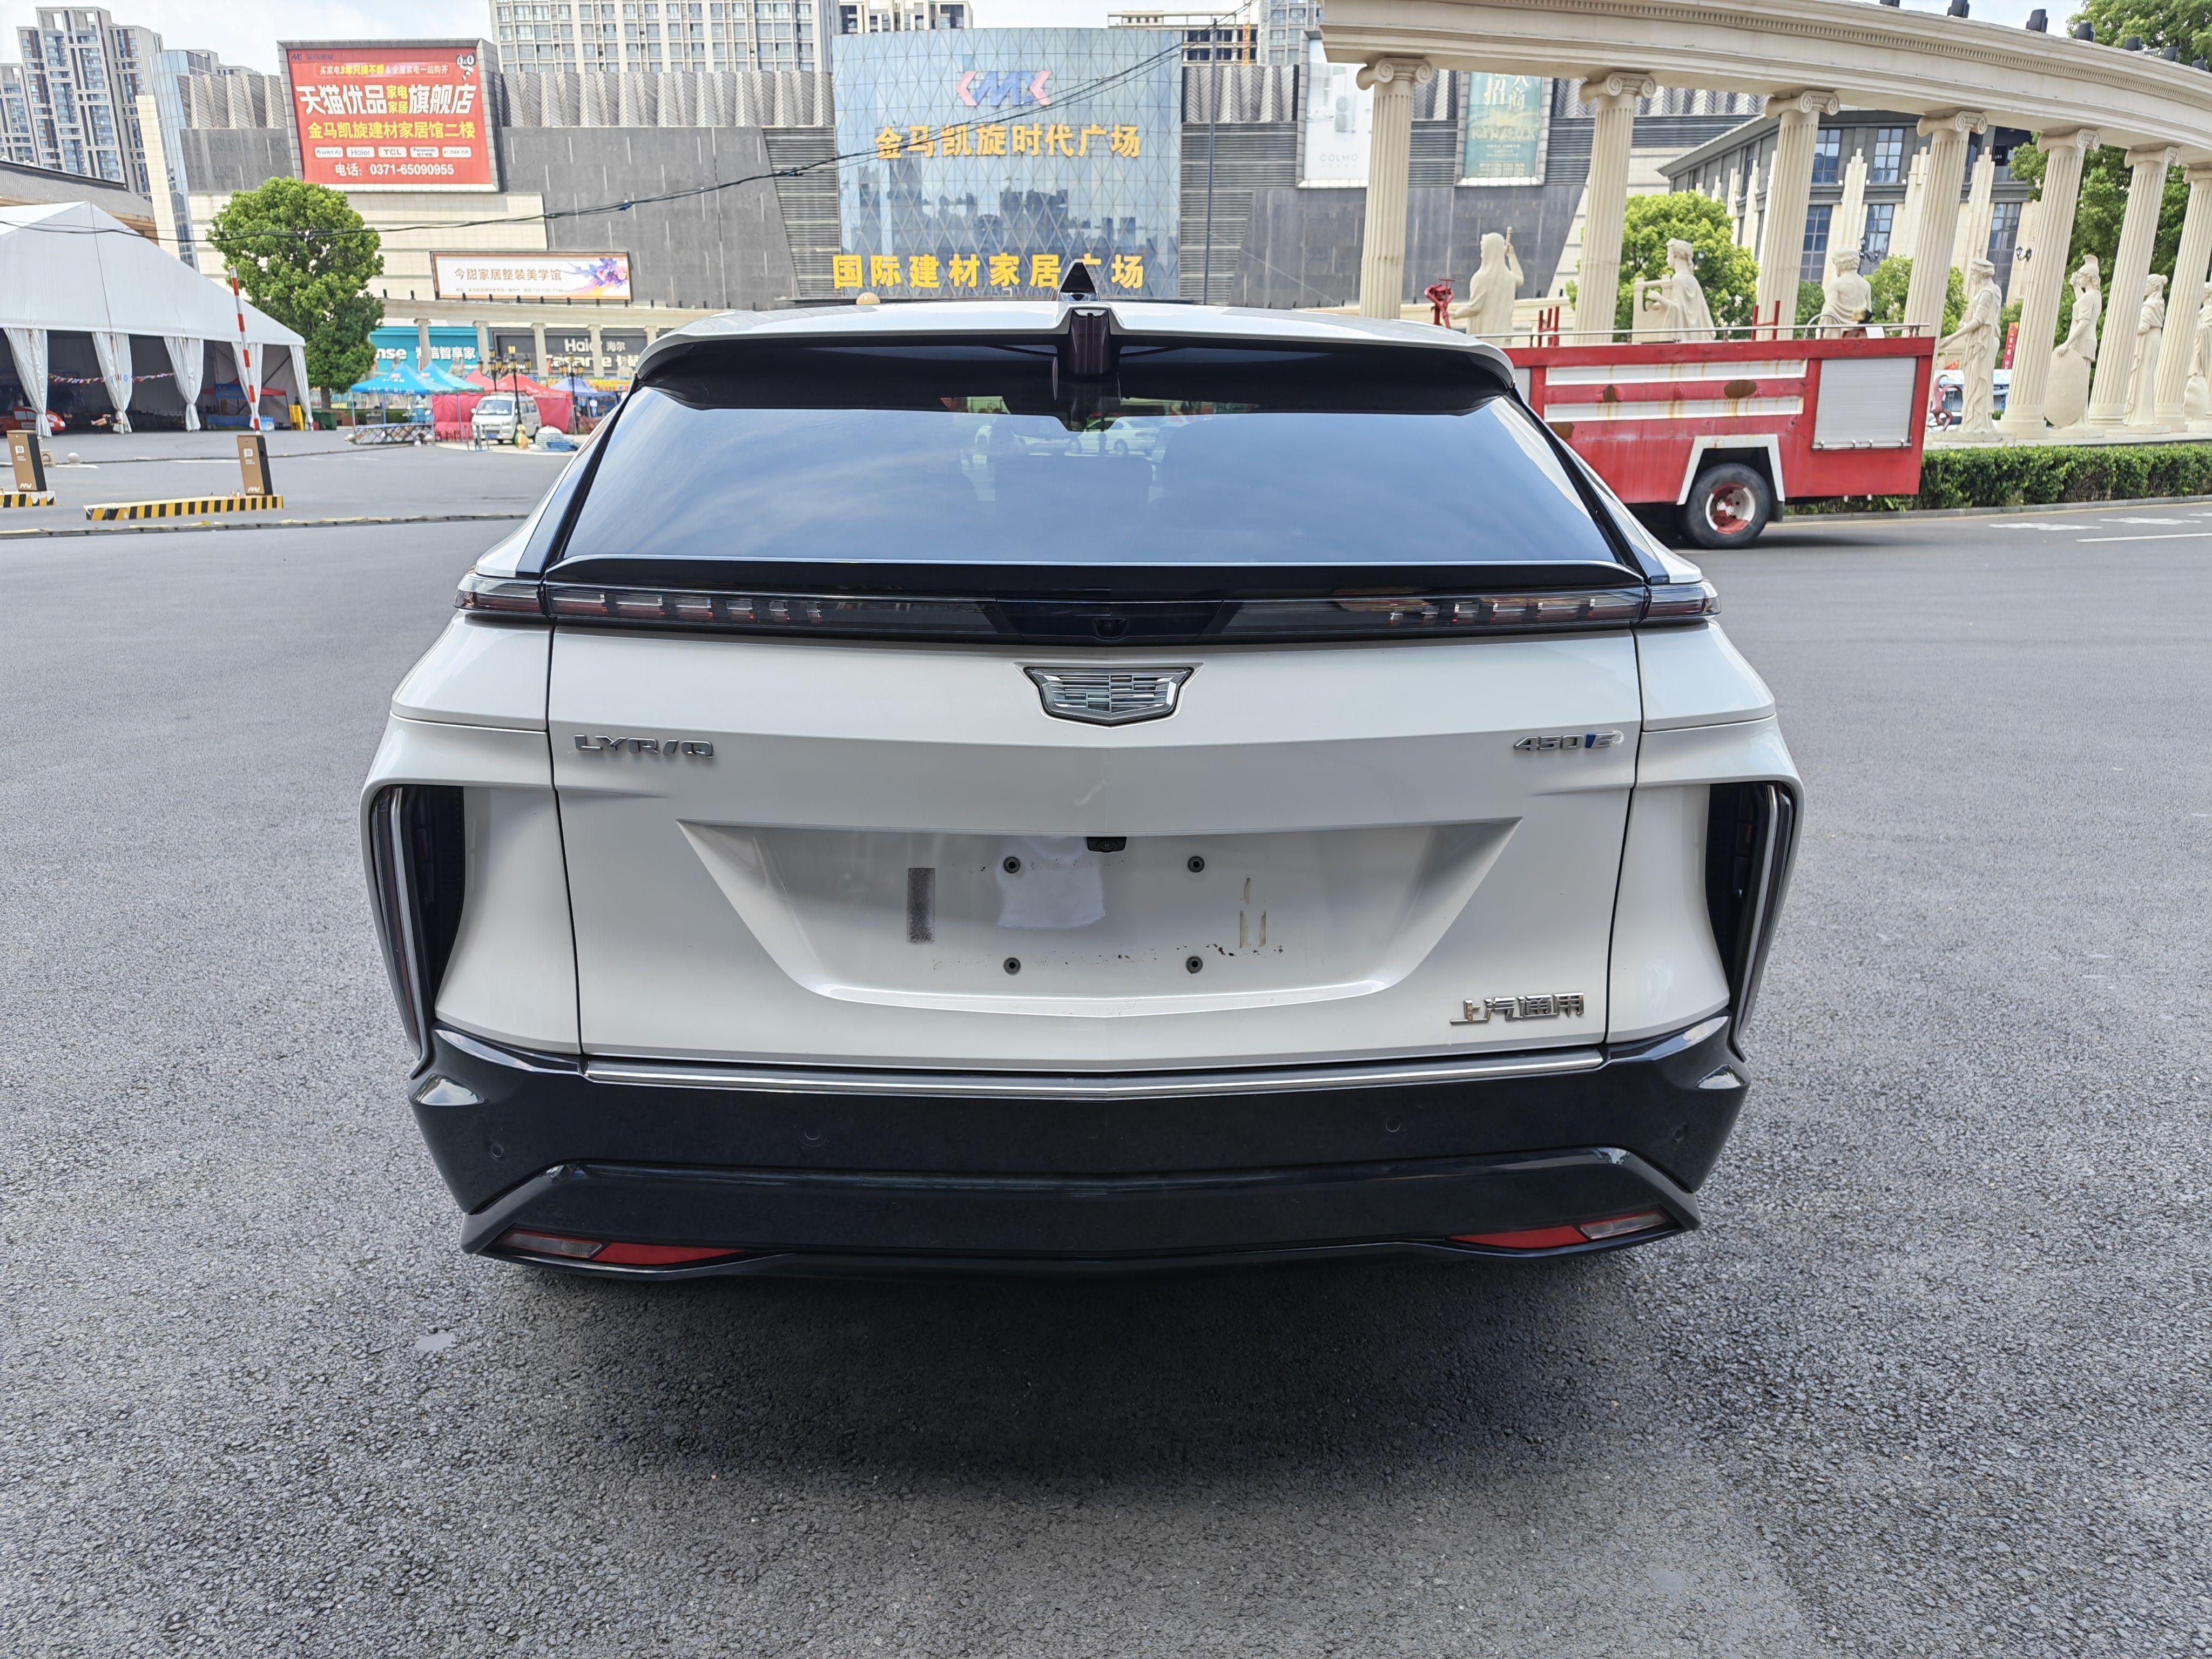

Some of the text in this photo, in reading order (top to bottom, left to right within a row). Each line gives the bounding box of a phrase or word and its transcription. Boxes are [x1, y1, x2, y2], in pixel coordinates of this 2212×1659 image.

[296, 84, 386, 114] 天猫优品
[408, 84, 476, 114] 旗舰店
[307, 122, 475, 139] 金马凯旋建材家居馆二楼
[875, 125, 1140, 159] 金马凯旋时代广场
[369, 164, 455, 175] 0371-65090955
[606, 341, 626, 352] 海尔
[574, 734, 714, 758] LYRIQ
[1449, 992, 1584, 1026] 上汽通用
